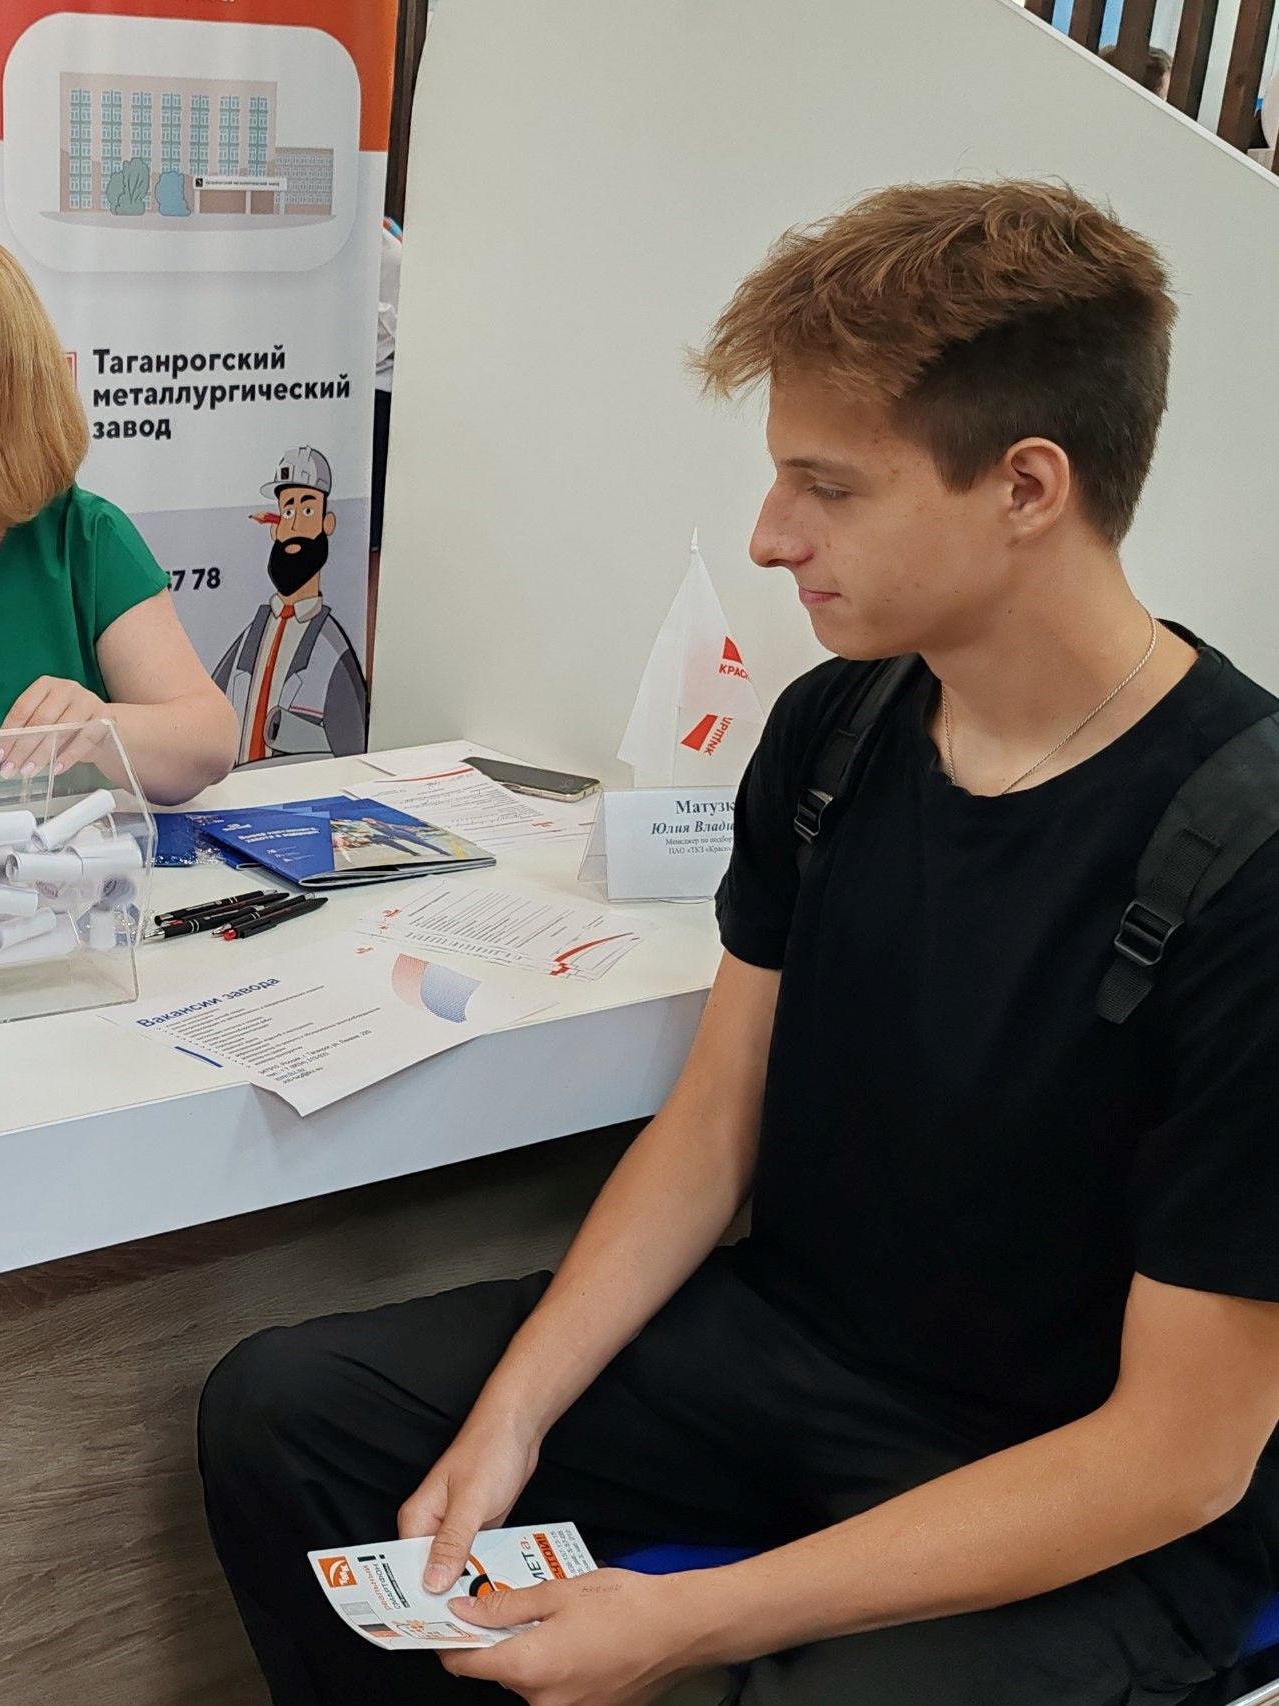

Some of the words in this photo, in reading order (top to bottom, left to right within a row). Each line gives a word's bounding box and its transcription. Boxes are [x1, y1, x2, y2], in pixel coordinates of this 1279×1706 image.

[92, 345, 285, 379] Таганрогский
[92, 374, 350, 410] металлургический
[92, 419, 172, 441] завод
[166, 570, 185, 591] 7
[192, 567, 221, 589] 78
[719, 664, 749, 680] КРАС
[650, 822, 690, 835] Юлия
[136, 997, 222, 1029] Вакансии
[221, 977, 281, 1001] завода
